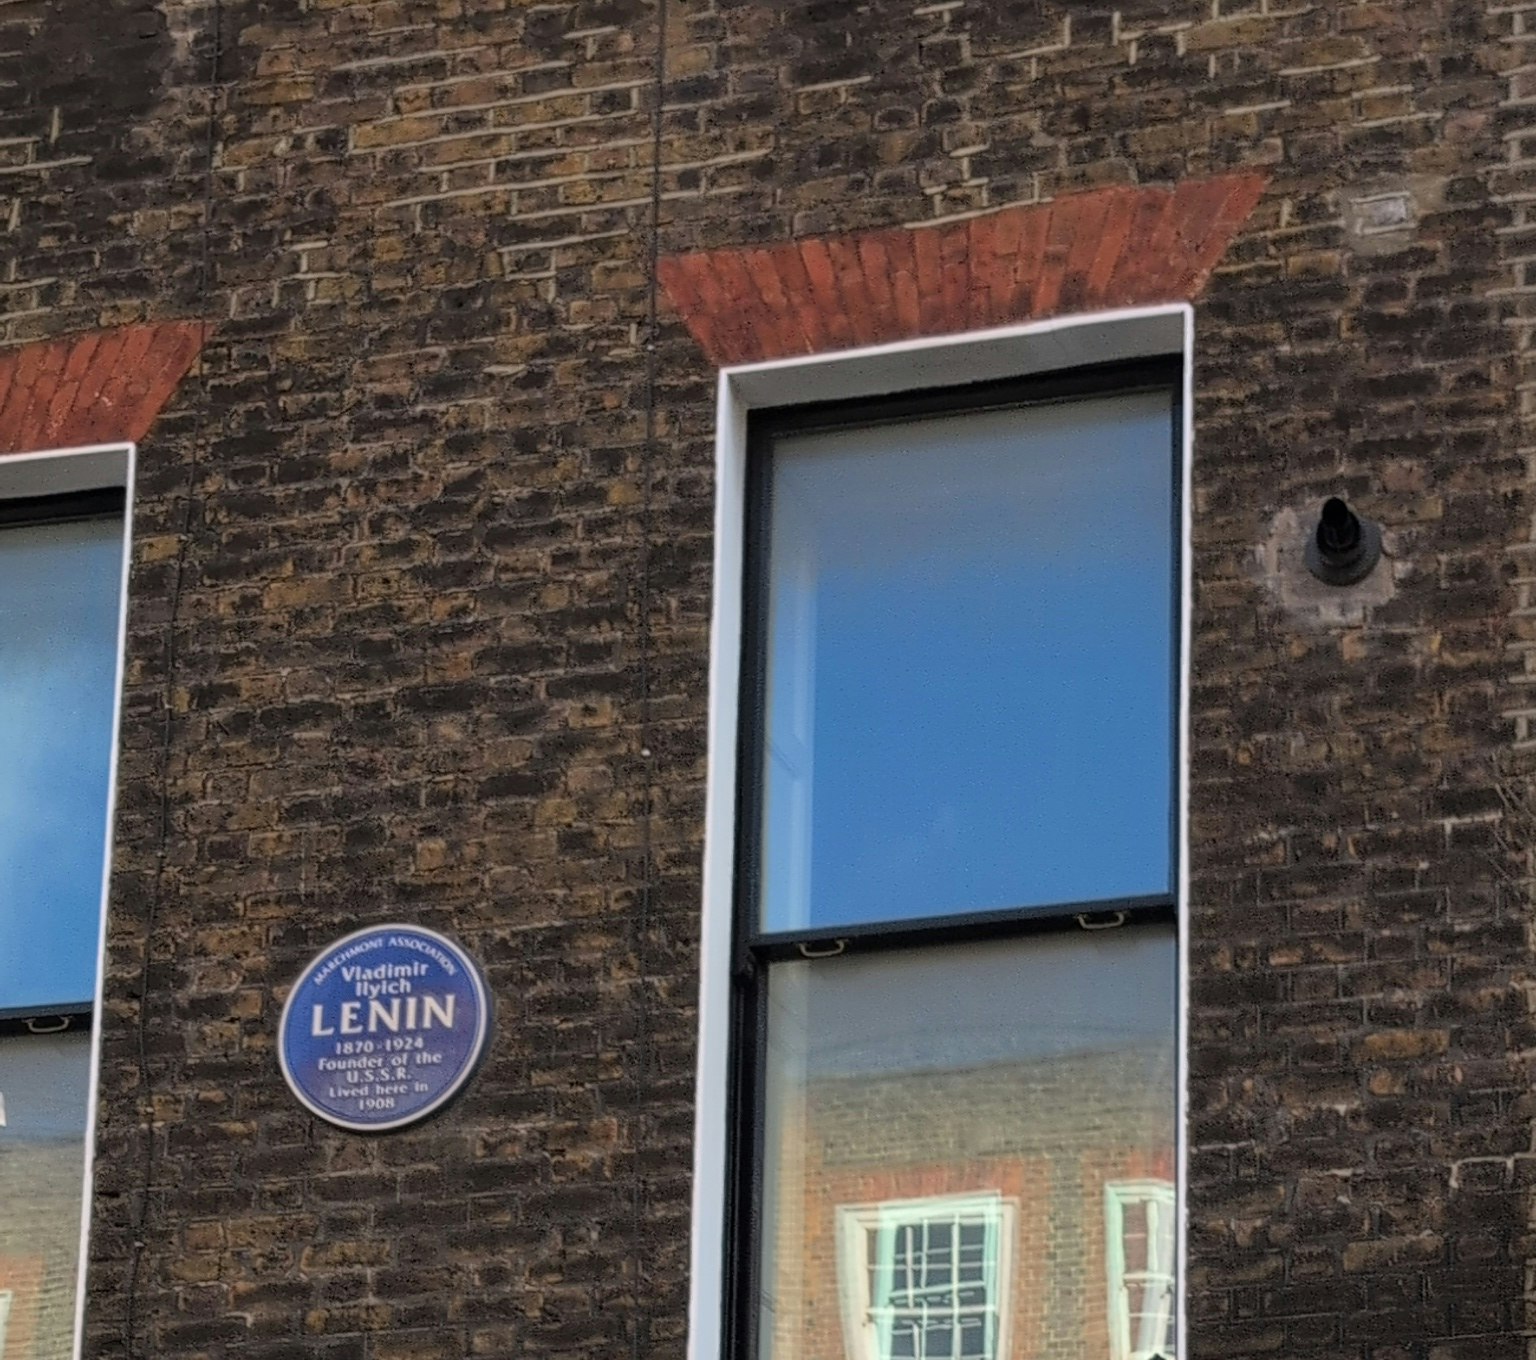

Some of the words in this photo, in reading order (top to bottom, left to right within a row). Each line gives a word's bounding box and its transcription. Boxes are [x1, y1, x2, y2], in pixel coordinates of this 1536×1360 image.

[314, 937, 383, 985] MARCHMONT
[388, 936, 456, 976] ASSOCIATION
[341, 961, 429, 981] Vladimir
[356, 978, 411, 999] Ilyich
[312, 994, 455, 1036] LENIN
[318, 1056, 383, 1071] Founder
[391, 1052, 407, 1066] of
[416, 1051, 442, 1064] the
[346, 1067, 411, 1083] U.S.S.R.
[330, 1085, 369, 1098] Lived
[376, 1083, 408, 1095] here
[415, 1081, 428, 1092] in
[360, 1097, 395, 1110] 1908
